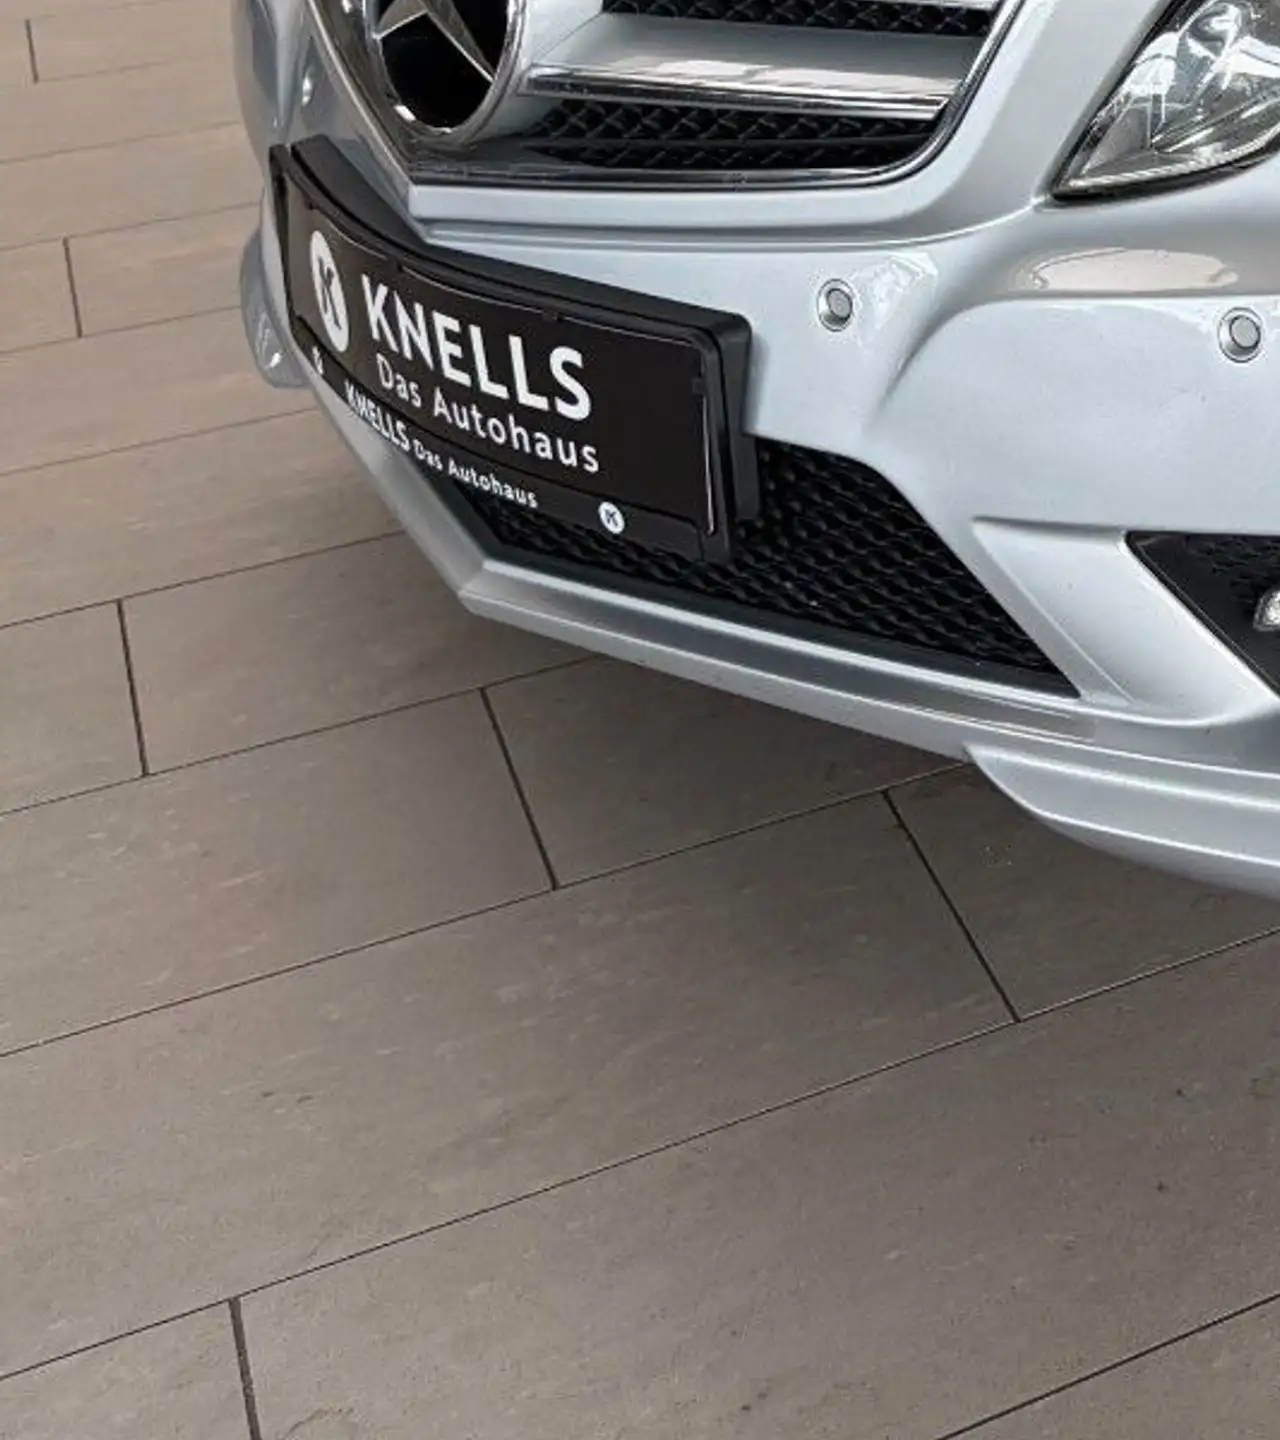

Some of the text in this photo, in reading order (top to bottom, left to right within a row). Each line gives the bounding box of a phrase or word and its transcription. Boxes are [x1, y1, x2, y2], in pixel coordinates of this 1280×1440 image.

[361, 273, 592, 421] KNELLS
[343, 380, 539, 509] KNELLS Das Autohaus
[376, 353, 422, 408] Das
[433, 386, 600, 474] Autohaus
